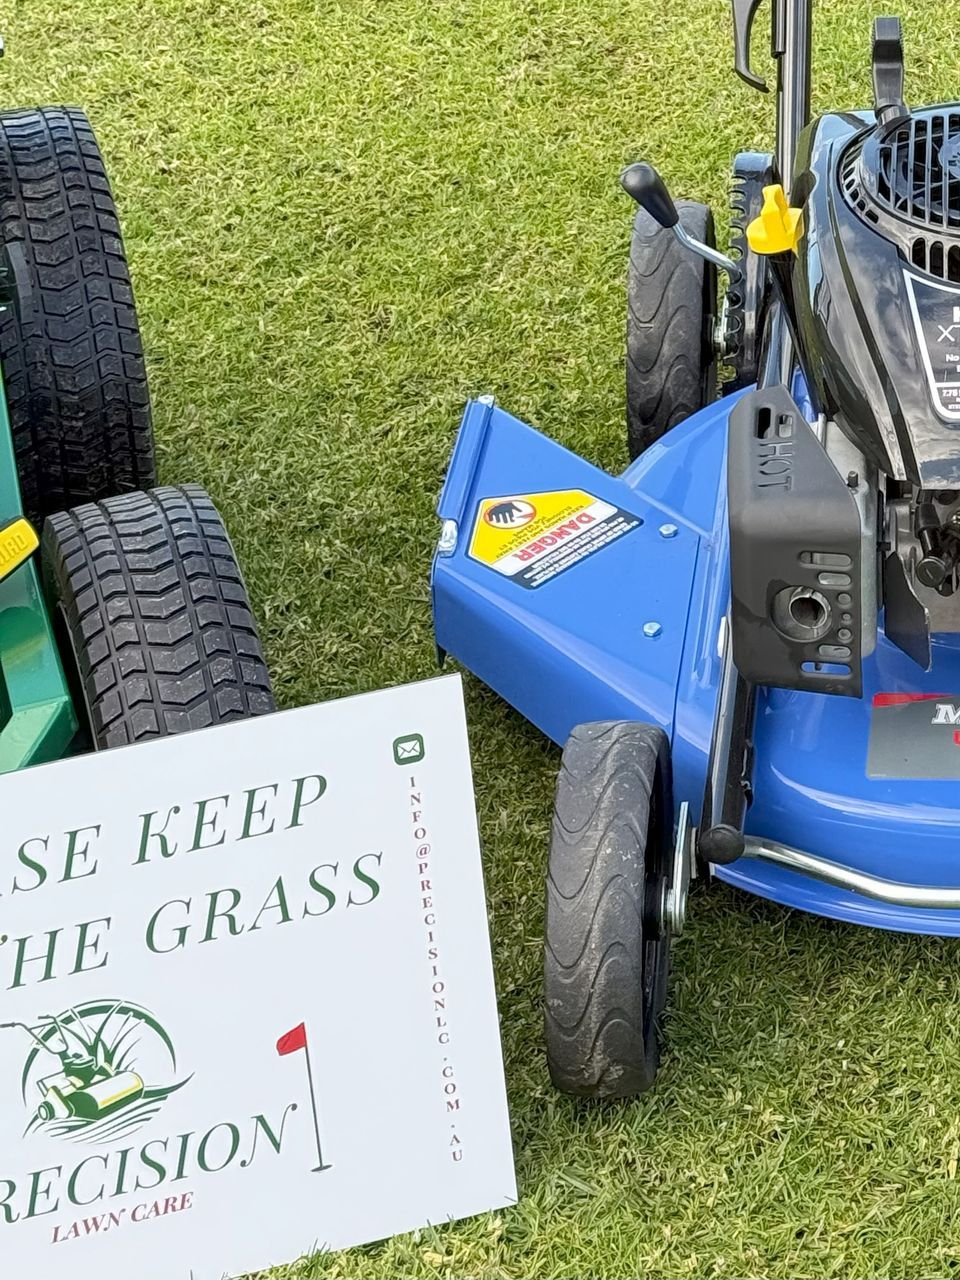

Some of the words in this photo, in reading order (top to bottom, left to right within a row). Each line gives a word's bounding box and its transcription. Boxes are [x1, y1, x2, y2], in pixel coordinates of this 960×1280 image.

[945, 353, 960, 362] No
[757, 440, 794, 491] HOT
[511, 512, 597, 562] DANGER
[0, 824, 102, 896] SE
[131, 773, 328, 866] KEEP
[0, 916, 112, 990] HE
[145, 851, 383, 954] GRASS
[51, 1207, 126, 1244] LAWN
[130, 1191, 194, 1222] CARE
